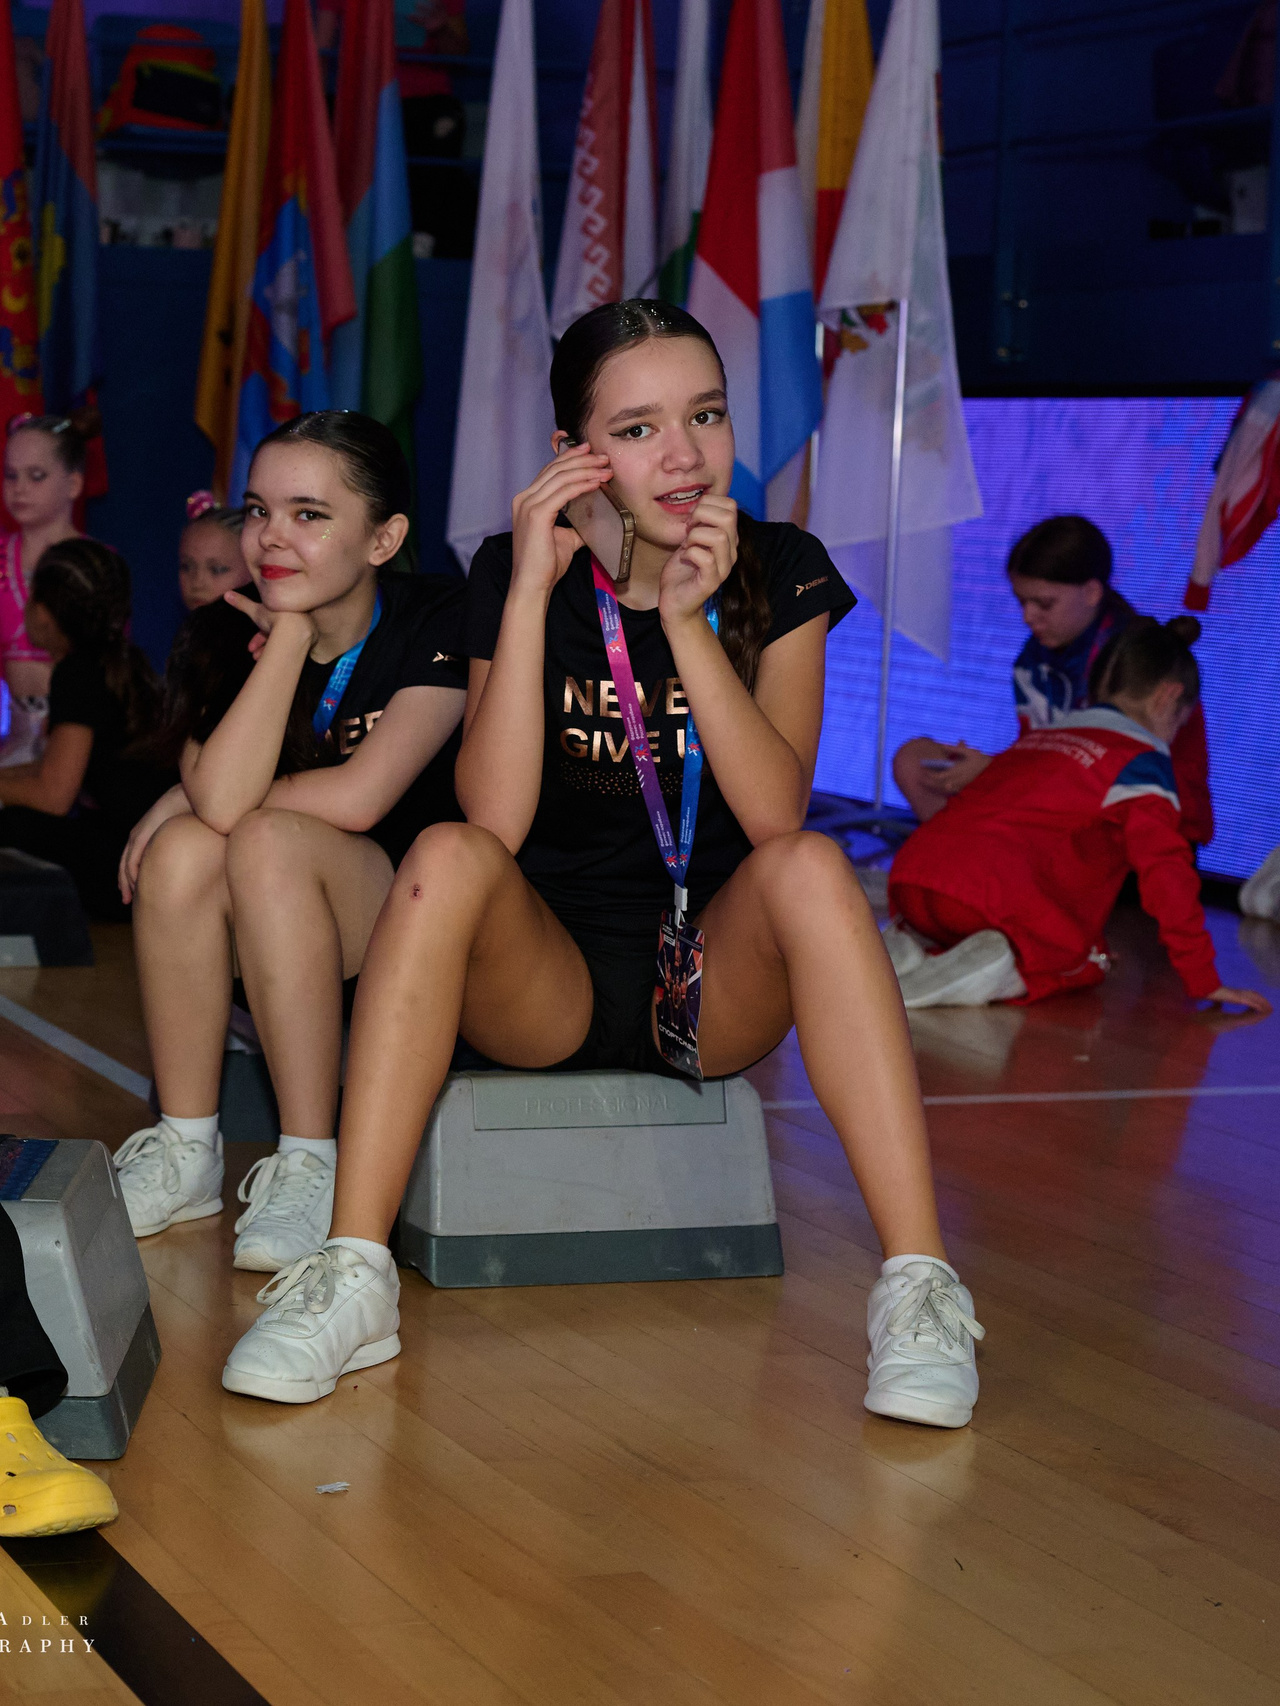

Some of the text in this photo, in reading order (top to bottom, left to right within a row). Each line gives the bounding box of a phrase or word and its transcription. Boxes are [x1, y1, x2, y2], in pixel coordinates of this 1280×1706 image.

[563, 676, 689, 718] NEVE
[559, 728, 661, 763] GIVE
[524, 1094, 670, 1115] PROFESSIONAL
